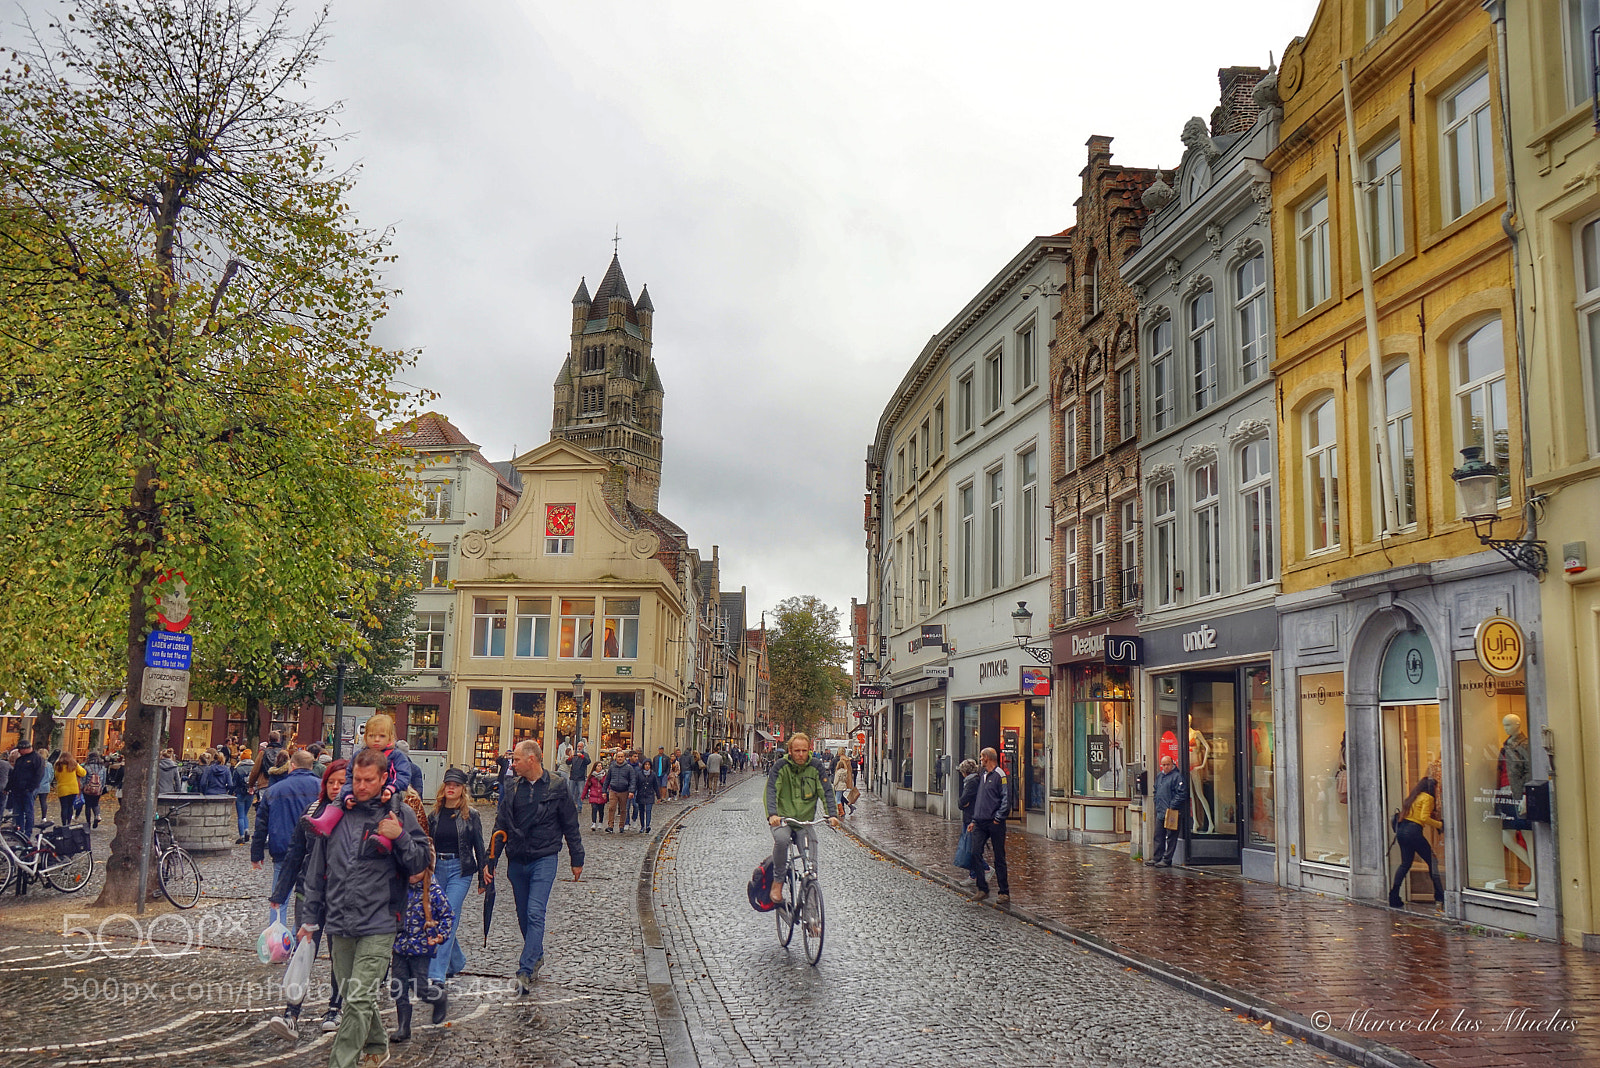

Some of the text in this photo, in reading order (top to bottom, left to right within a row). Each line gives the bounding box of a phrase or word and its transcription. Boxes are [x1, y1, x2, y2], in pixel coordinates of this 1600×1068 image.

[158, 633, 186, 642] Uitgezonderd
[1182, 624, 1217, 652] undiz
[151, 641, 167, 649] LADEN
[172, 643, 190, 651] LOSSEN
[980, 659, 1008, 684] pimkie
[149, 674, 186, 682] UITGEZONDERD
